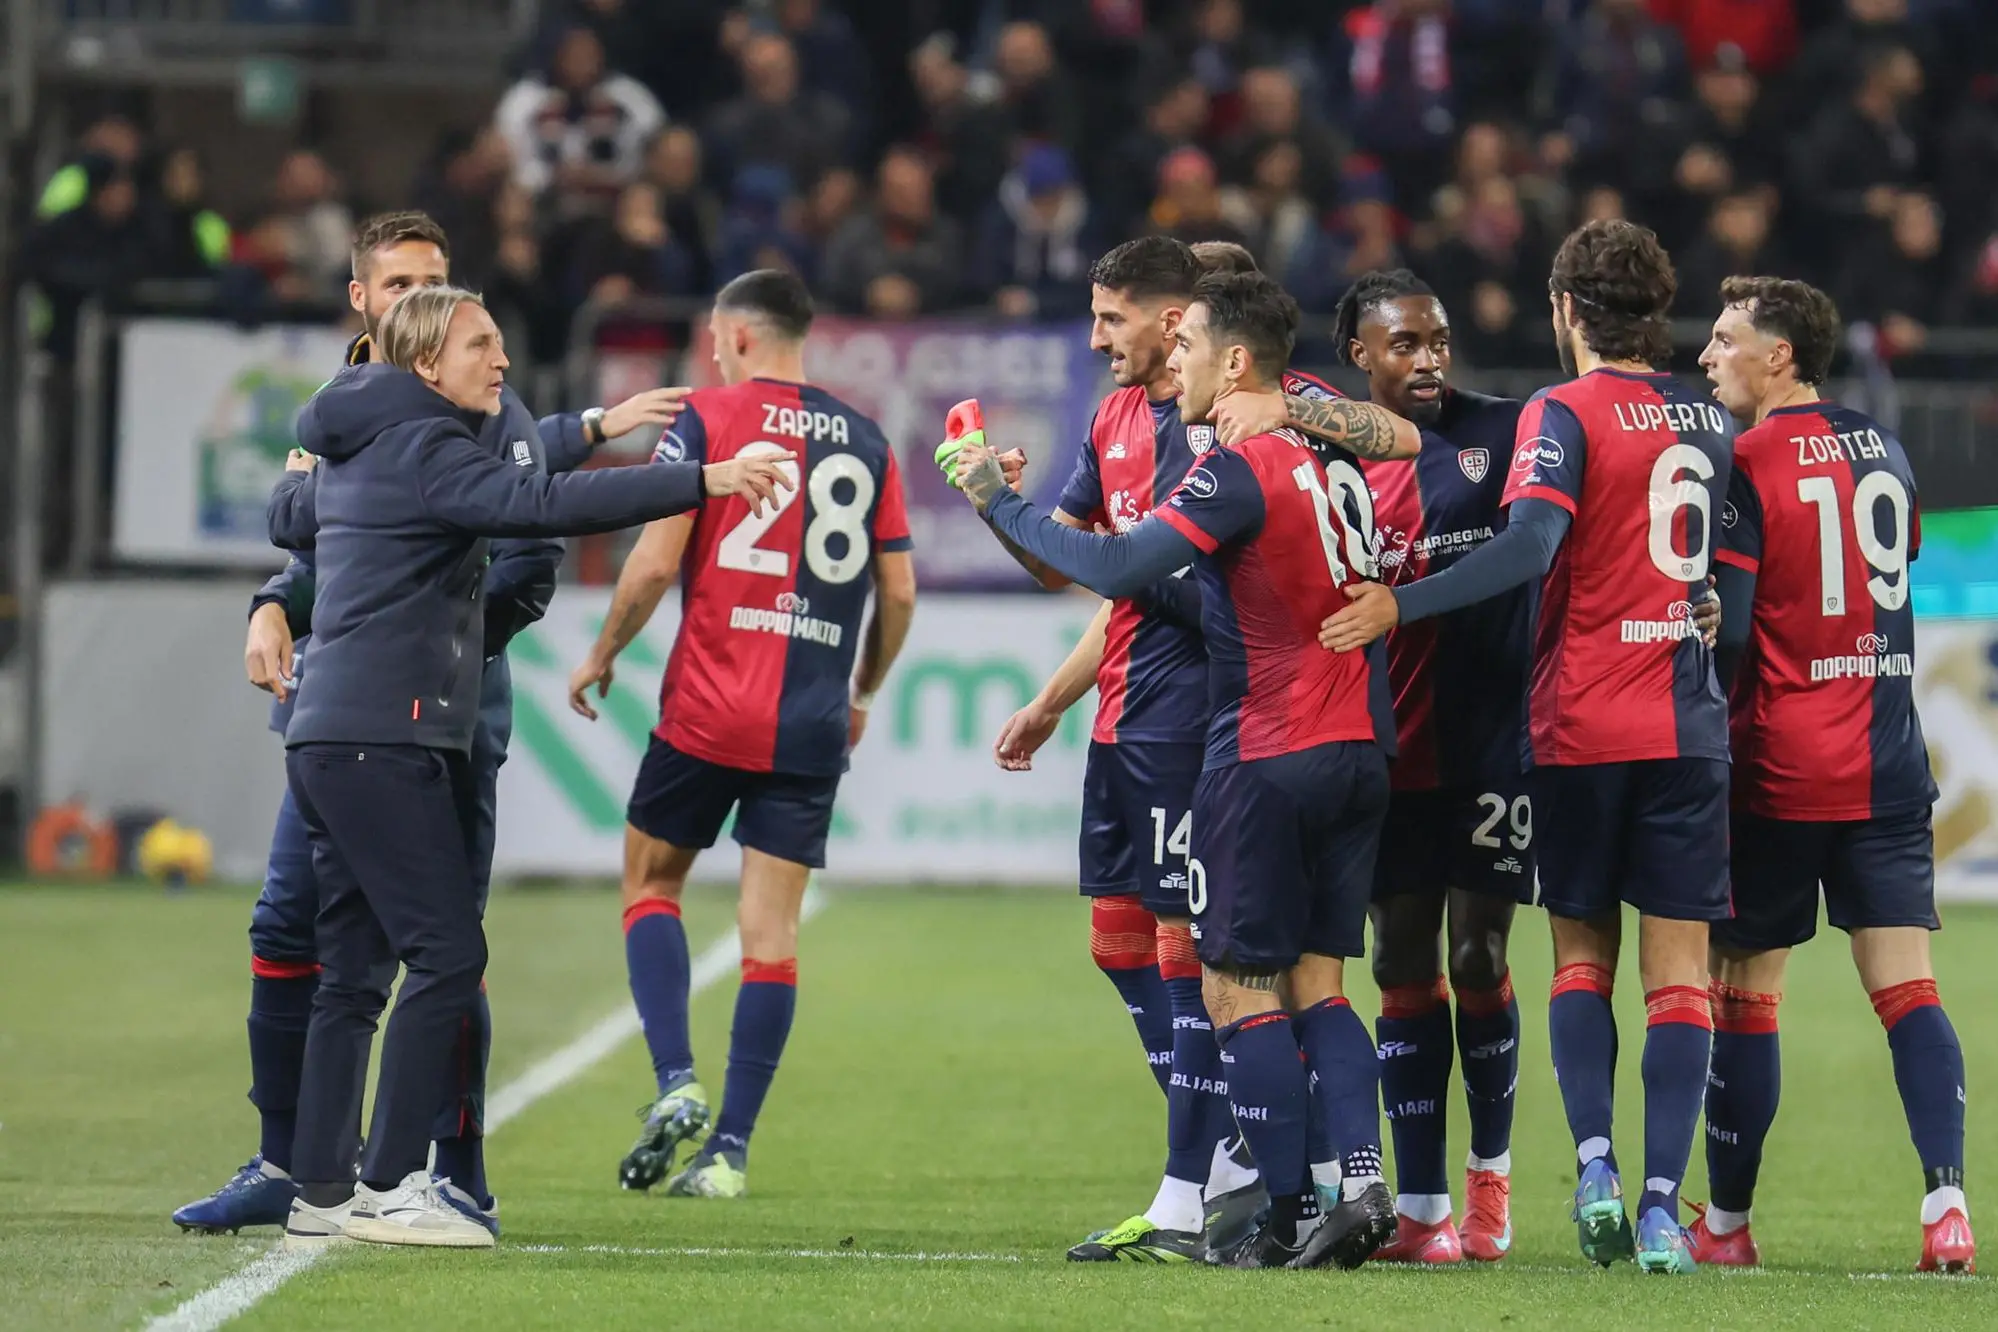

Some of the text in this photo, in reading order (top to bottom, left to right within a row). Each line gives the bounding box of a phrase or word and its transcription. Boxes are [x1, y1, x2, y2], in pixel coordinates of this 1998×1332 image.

[761, 403, 849, 445] ZAPPA
[1614, 401, 1725, 434] LUPERTO
[1790, 428, 1887, 466] ZORTEA
[716, 440, 875, 585] 28
[1291, 459, 1380, 589] 10
[1413, 526, 1494, 552] SARDEGNA
[1648, 443, 1715, 582] 6
[1797, 470, 1909, 617] 19
[1150, 806, 1192, 866] 14
[1471, 792, 1533, 850] 29
[1188, 858, 1208, 915] 0
[1169, 1073, 1229, 1096] GLIARI
